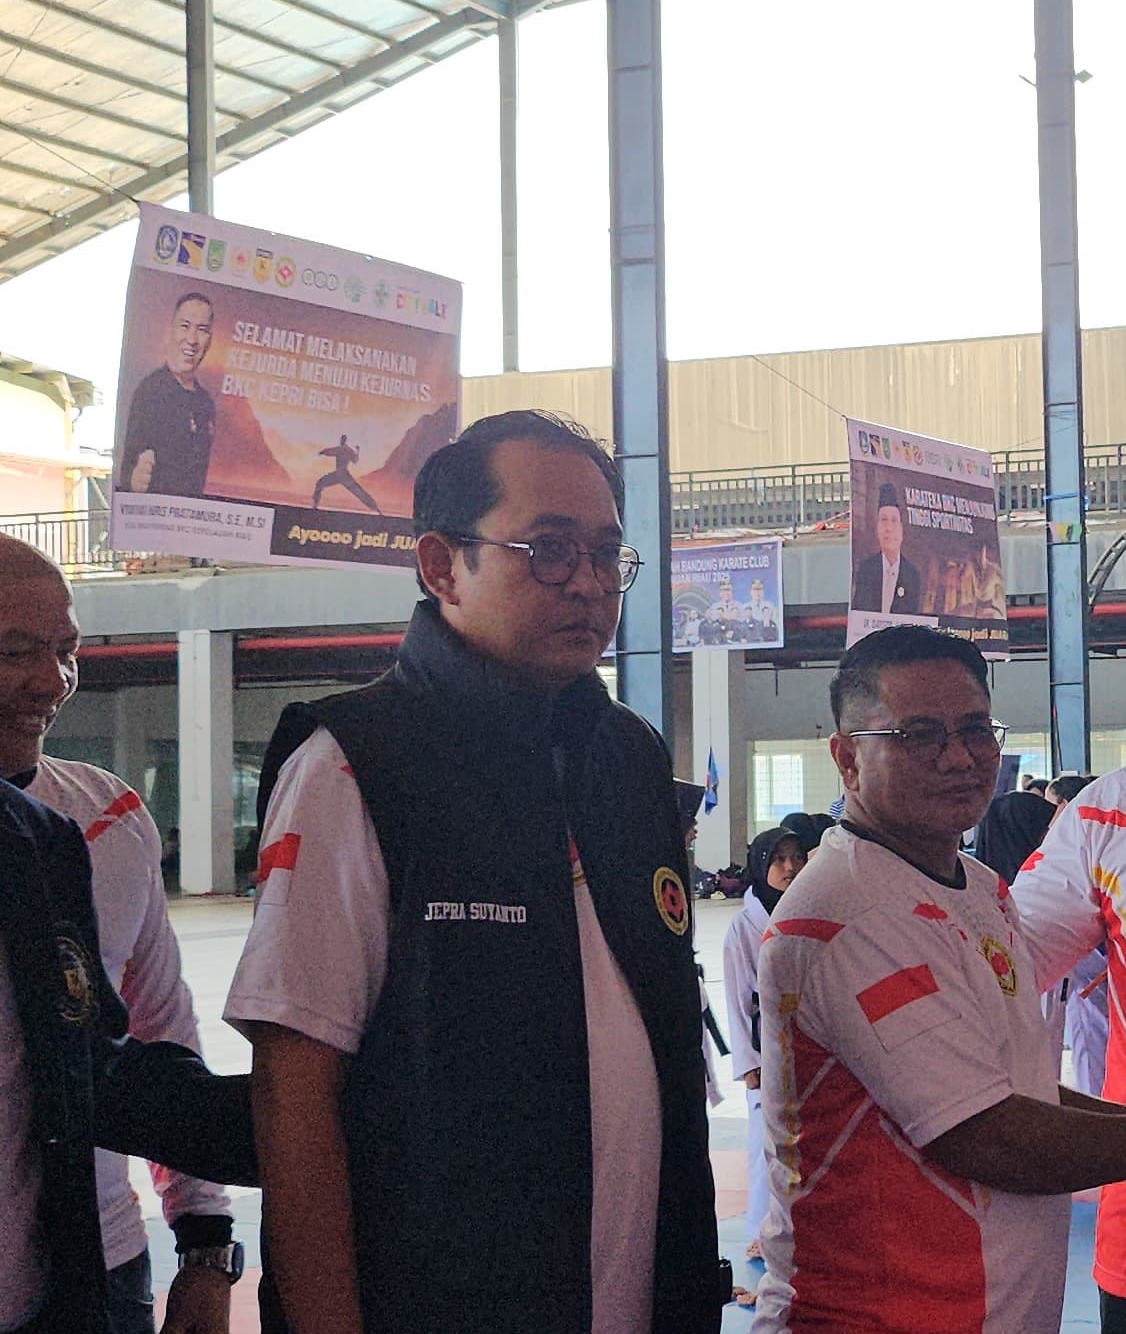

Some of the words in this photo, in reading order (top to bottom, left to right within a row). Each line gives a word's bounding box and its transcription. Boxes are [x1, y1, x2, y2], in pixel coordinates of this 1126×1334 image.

[232, 321, 304, 354] SELAMAT
[306, 335, 417, 376] MELAKSANAKAN
[227, 347, 297, 378] KEJURDA
[300, 361, 358, 390] MENUJU
[221, 374, 255, 398] BKC
[258, 380, 304, 406] KEPRI
[307, 387, 340, 412] BISA
[353, 530, 388, 549] jadi
[680, 557, 718, 572] BANDUNG
[719, 556, 750, 571] KARATE
[749, 555, 770, 568] CLUB
[424, 902, 466, 921] JEPRA
[470, 902, 527, 923] SUYANTO
